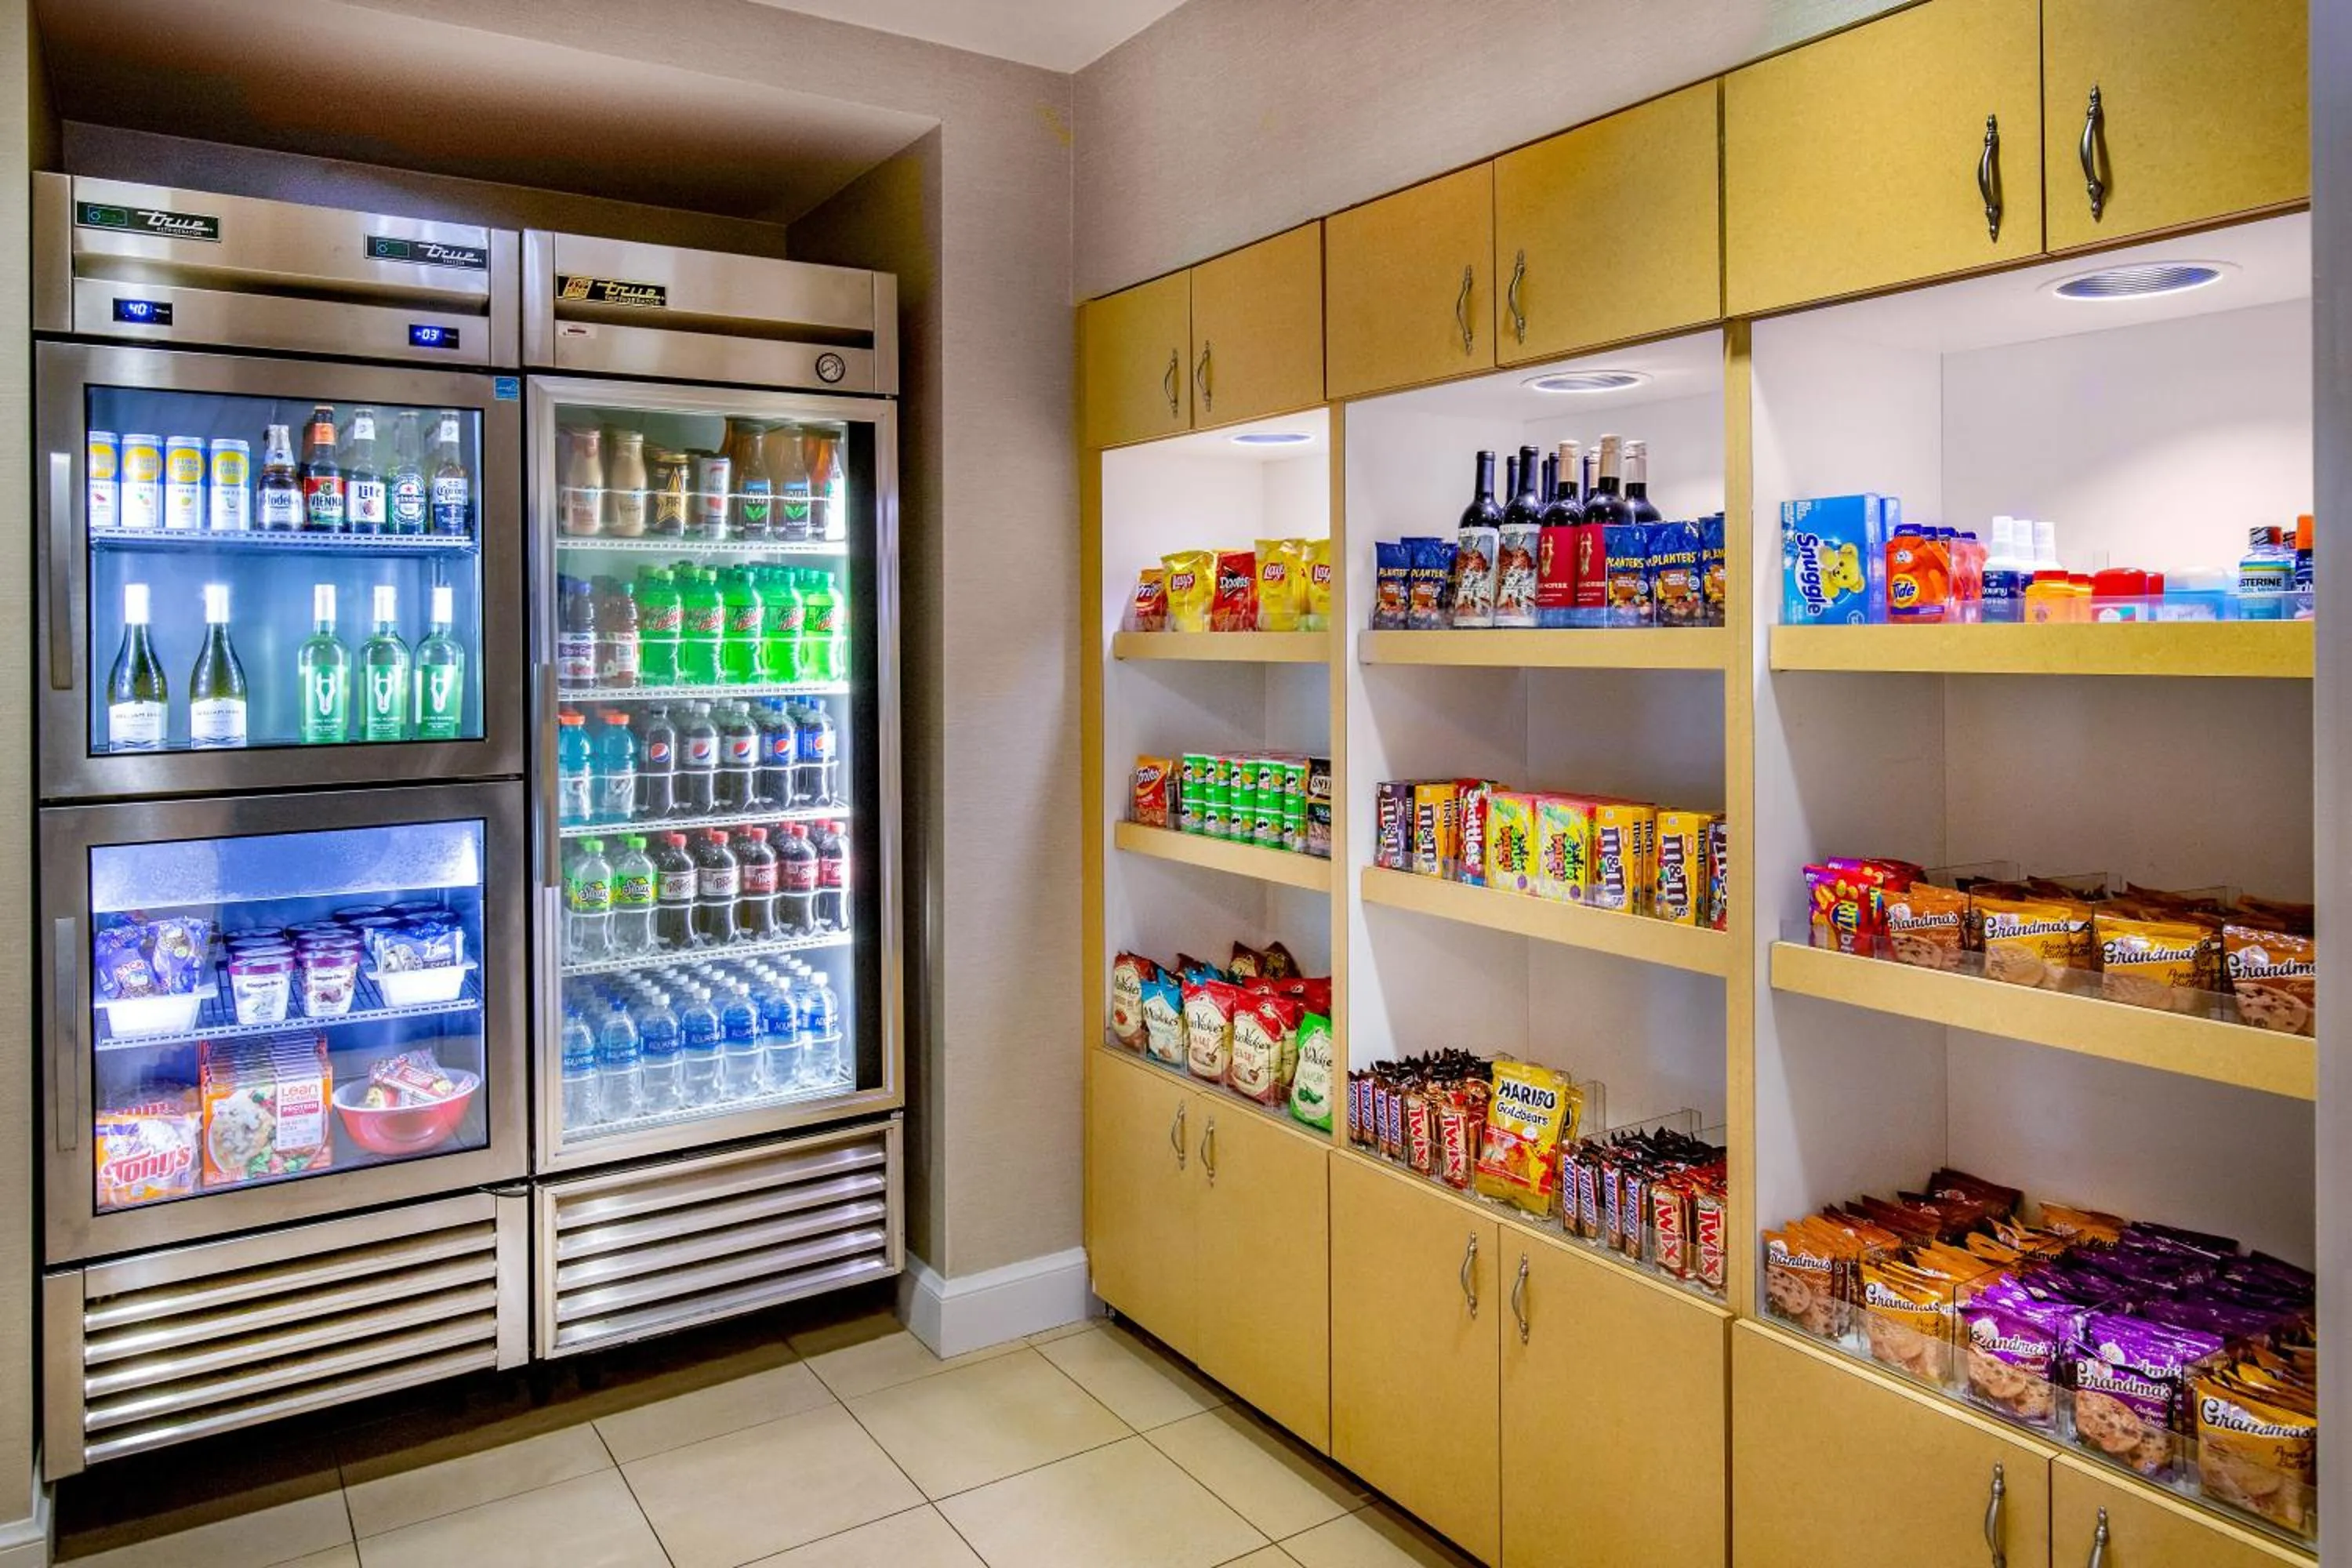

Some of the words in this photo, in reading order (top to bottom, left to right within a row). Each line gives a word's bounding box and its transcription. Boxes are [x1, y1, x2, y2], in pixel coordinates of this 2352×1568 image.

[128, 303, 148, 316] 40
[358, 485, 381, 499] Lite
[1652, 551, 1697, 566] PLANTERS
[1796, 534, 1827, 615] Snuggle
[1219, 576, 1250, 590] Doritos
[1892, 580, 1915, 599] Tide
[1466, 789, 1482, 866] Skittles
[1552, 834, 1564, 881] PATCH
[1564, 835, 1575, 880] SOUR
[1837, 901, 1857, 933] RITZ
[1984, 916, 2070, 939] Grandma's
[1497, 1102, 1548, 1127] Goldbears
[1498, 1080, 1555, 1109] HARIBO
[1410, 1104, 1428, 1164] TWIX
[1443, 1114, 1463, 1174] TWIX
[108, 1145, 192, 1187] Tony's
[1656, 1198, 1678, 1261] TWIX
[1699, 1207, 1722, 1278] TWIX
[2077, 1361, 2171, 1401] Grandma's
[2201, 1398, 2310, 1439] Grandma's
